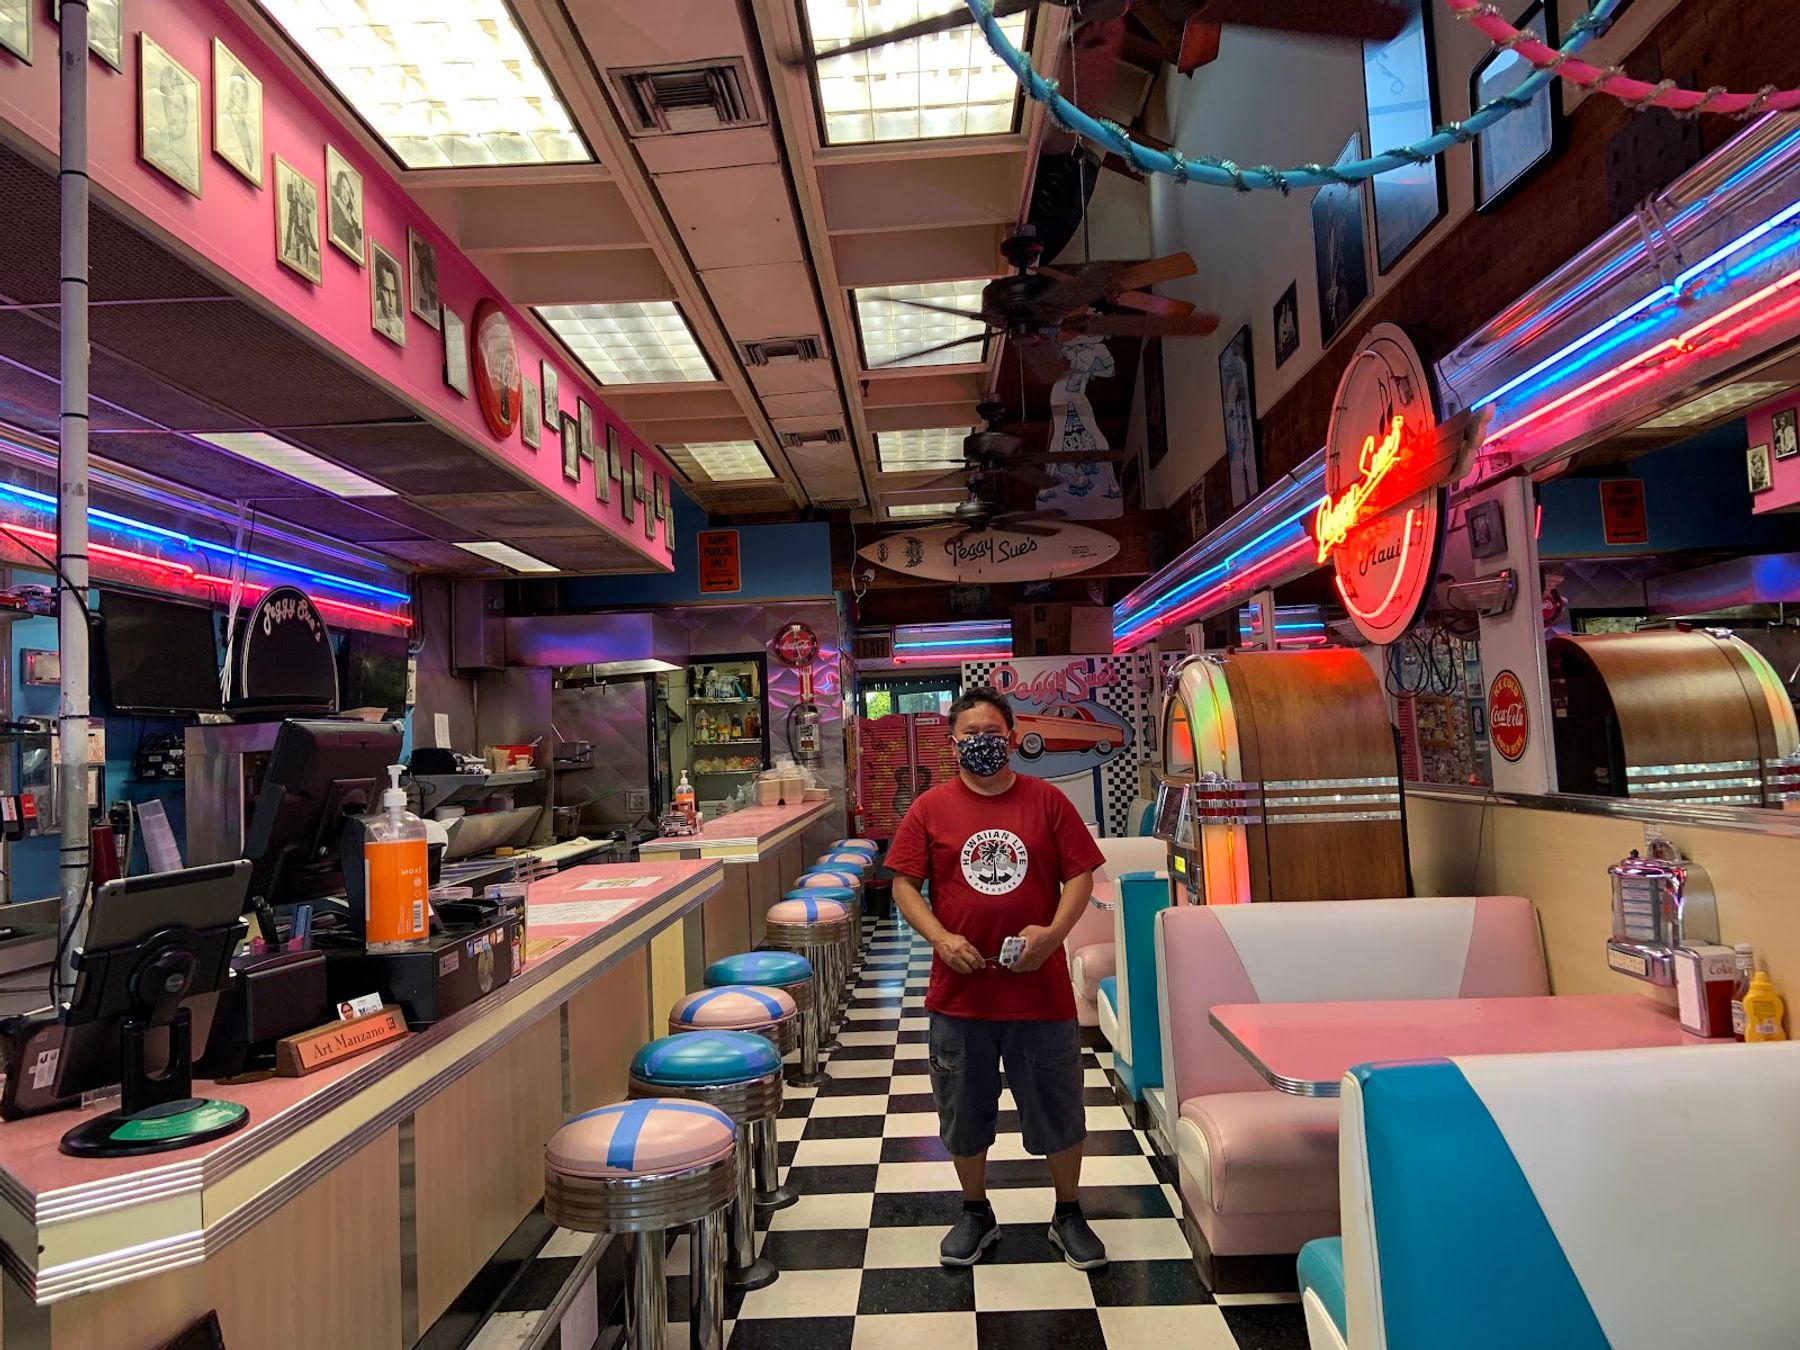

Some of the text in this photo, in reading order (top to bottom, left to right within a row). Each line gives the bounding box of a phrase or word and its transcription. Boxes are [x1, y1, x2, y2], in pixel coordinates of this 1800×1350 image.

[945, 537, 994, 566] Peggy
[997, 537, 1038, 563] Sue's
[1359, 538, 1401, 576] Maui
[263, 598, 296, 636] Peggy
[863, 639, 885, 656] EXIT
[990, 660, 1121, 705] Peggy Sue's
[1493, 677, 1520, 697] ICE COLD
[1491, 703, 1524, 728] Coca-Cola
[962, 831, 1027, 866] HAWAIIAN LIFE
[974, 881, 1017, 893] PARADISE
[313, 1028, 385, 1059] Art Manzano
